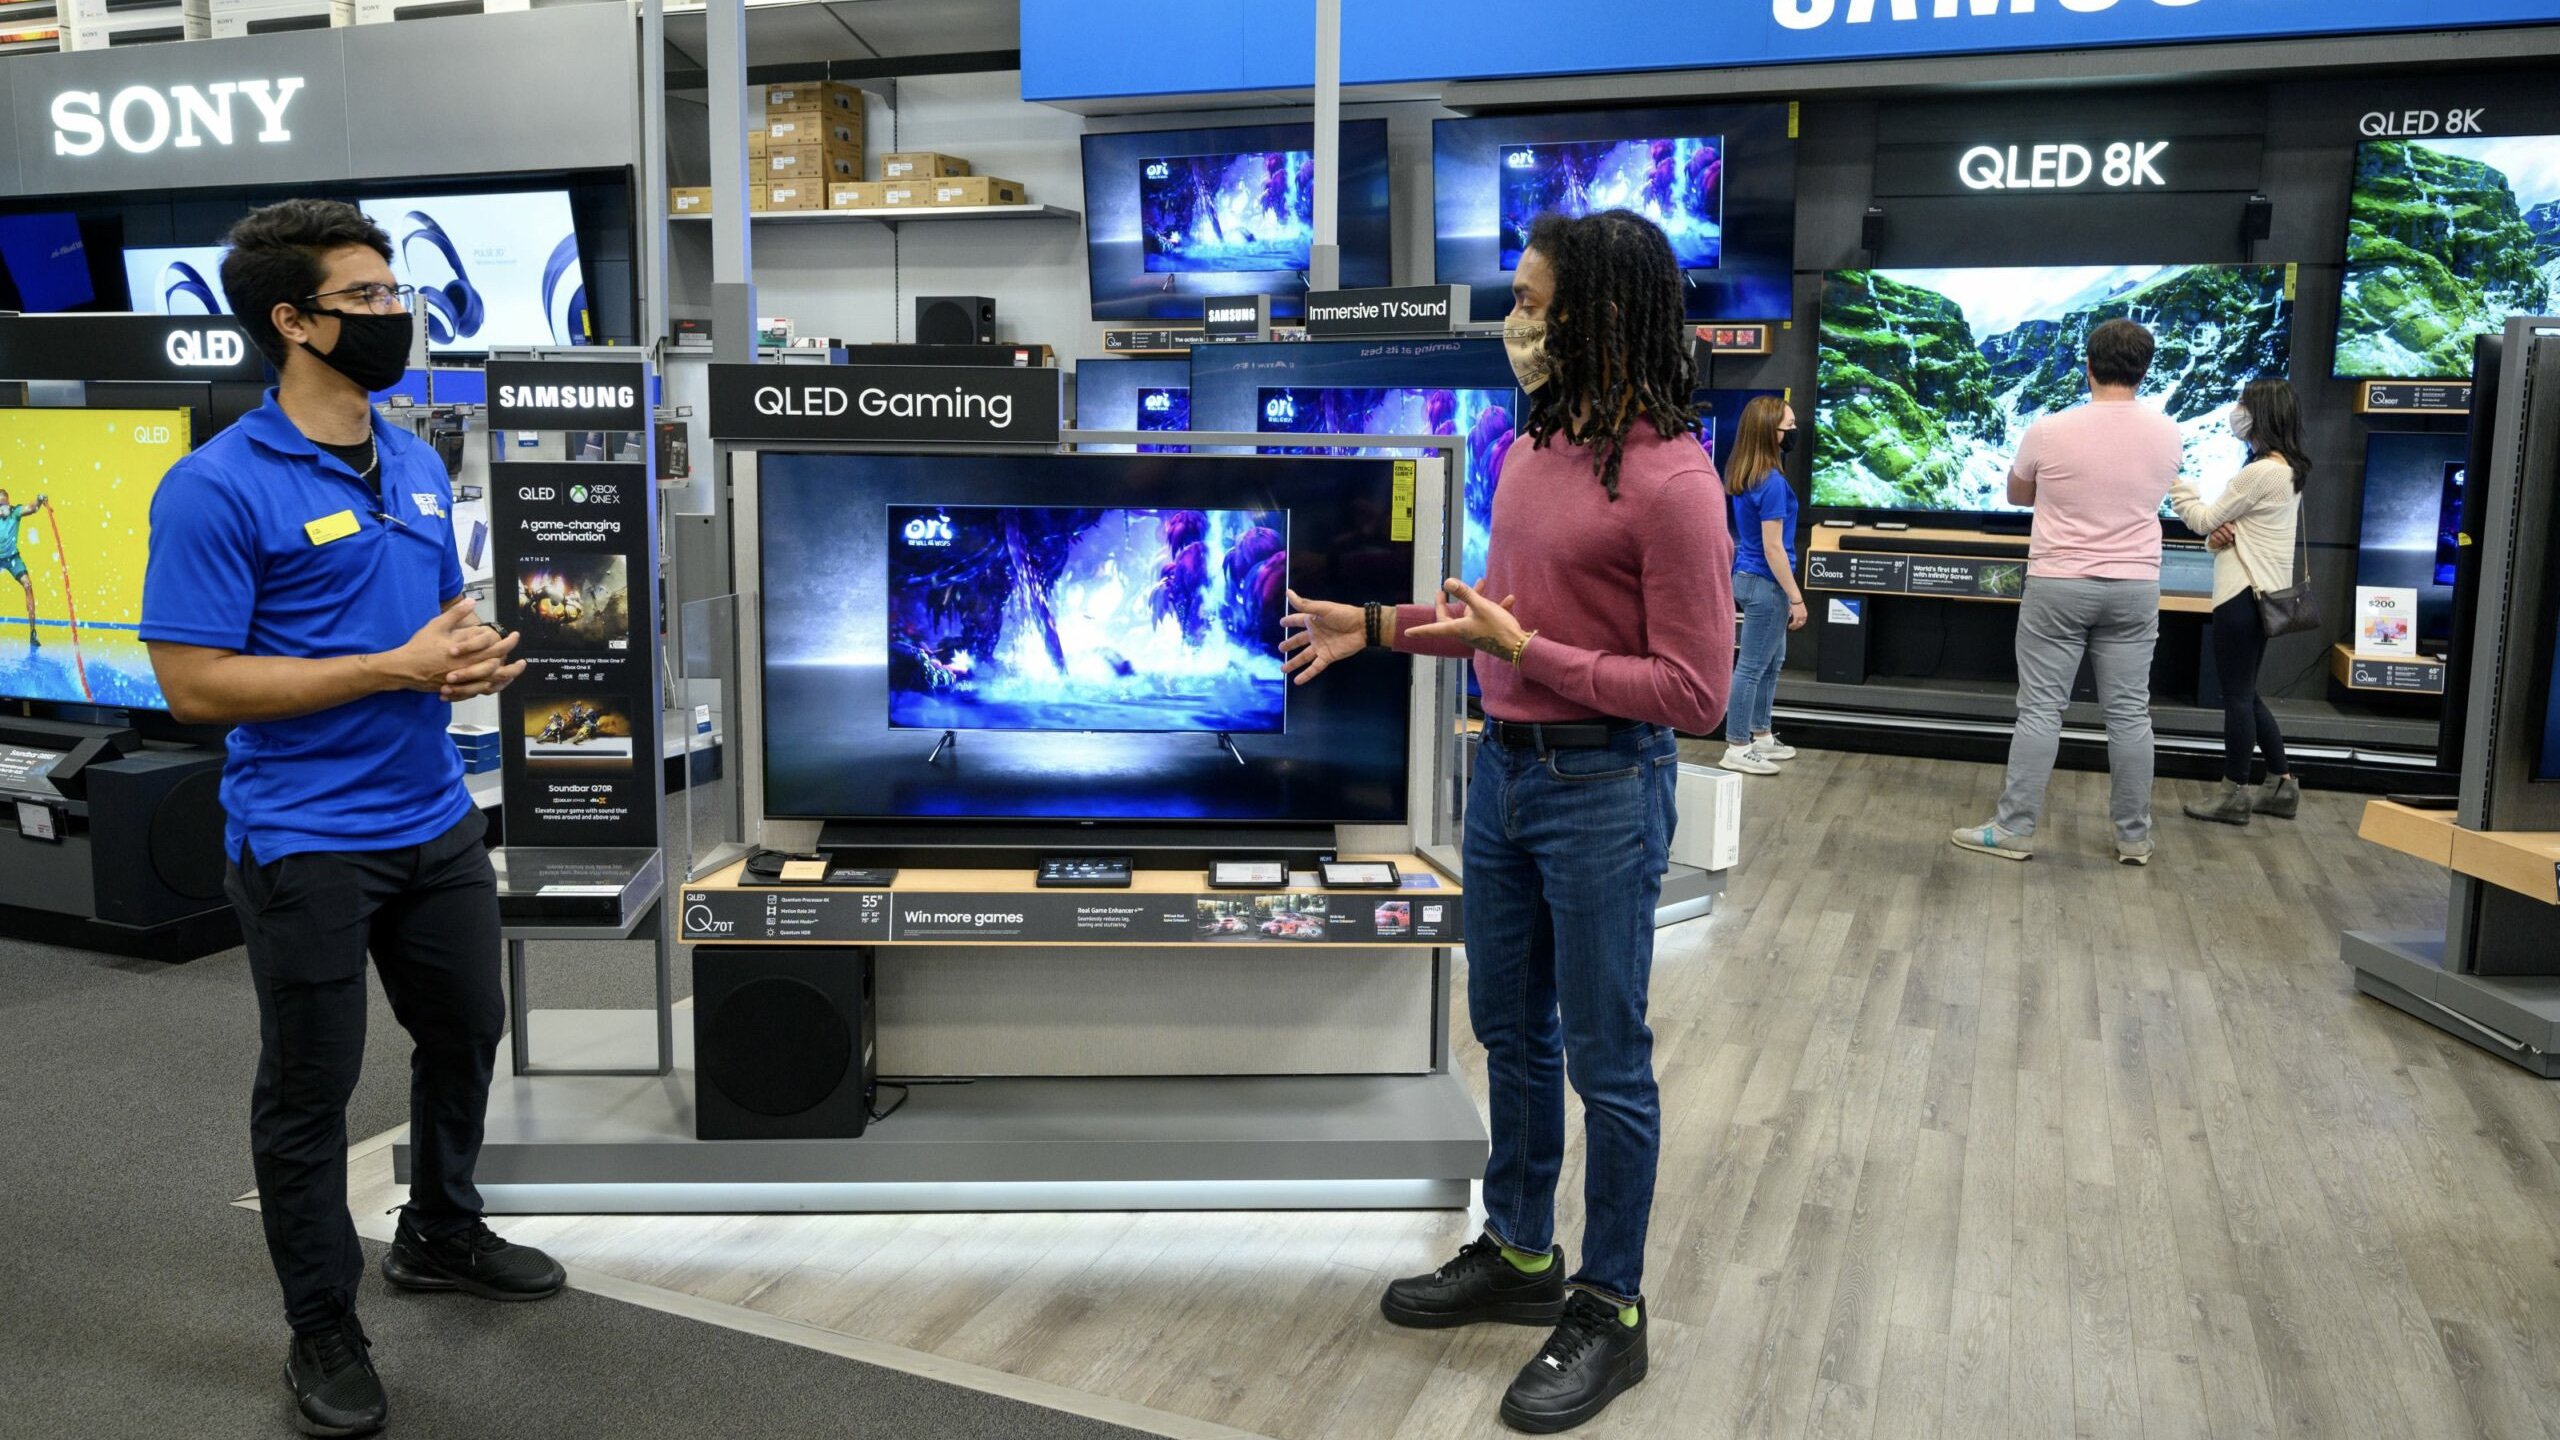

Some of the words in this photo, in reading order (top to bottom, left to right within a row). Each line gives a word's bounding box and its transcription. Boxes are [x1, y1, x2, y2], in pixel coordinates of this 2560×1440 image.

[51, 77, 304, 156] SONY
[2359, 111, 2439, 137] QLED
[2445, 109, 2486, 134] 8K
[1958, 143, 2093, 190] QLED
[2101, 140, 2169, 187] 8K
[1208, 308, 1256, 323] SAMSUNG
[1310, 302, 1379, 321] Immersive
[1382, 302, 1398, 318] TV
[1401, 300, 1447, 317] Sound
[167, 330, 244, 366] QLED
[499, 386, 634, 408] SAMSUNG
[754, 386, 848, 416] QLED
[859, 386, 1012, 428] Gaming
[134, 426, 169, 444] QLED
[519, 487, 555, 500] QLED
[590, 485, 617, 494] XBOX
[590, 495, 611, 504] ONE
[612, 495, 620, 504] X
[520, 520, 529, 529] A
[530, 520, 620, 532] game-changing
[905, 514, 953, 539] ori
[536, 531, 606, 542] combination
[2369, 600, 2395, 608] $200
[548, 784, 589, 792] Soundbar
[591, 784, 613, 792] Q70R
[861, 895, 883, 907] 55"
[685, 904, 734, 932] Q70T
[904, 910, 931, 923] Win
[934, 913, 972, 923] more
[974, 913, 1024, 926] games
